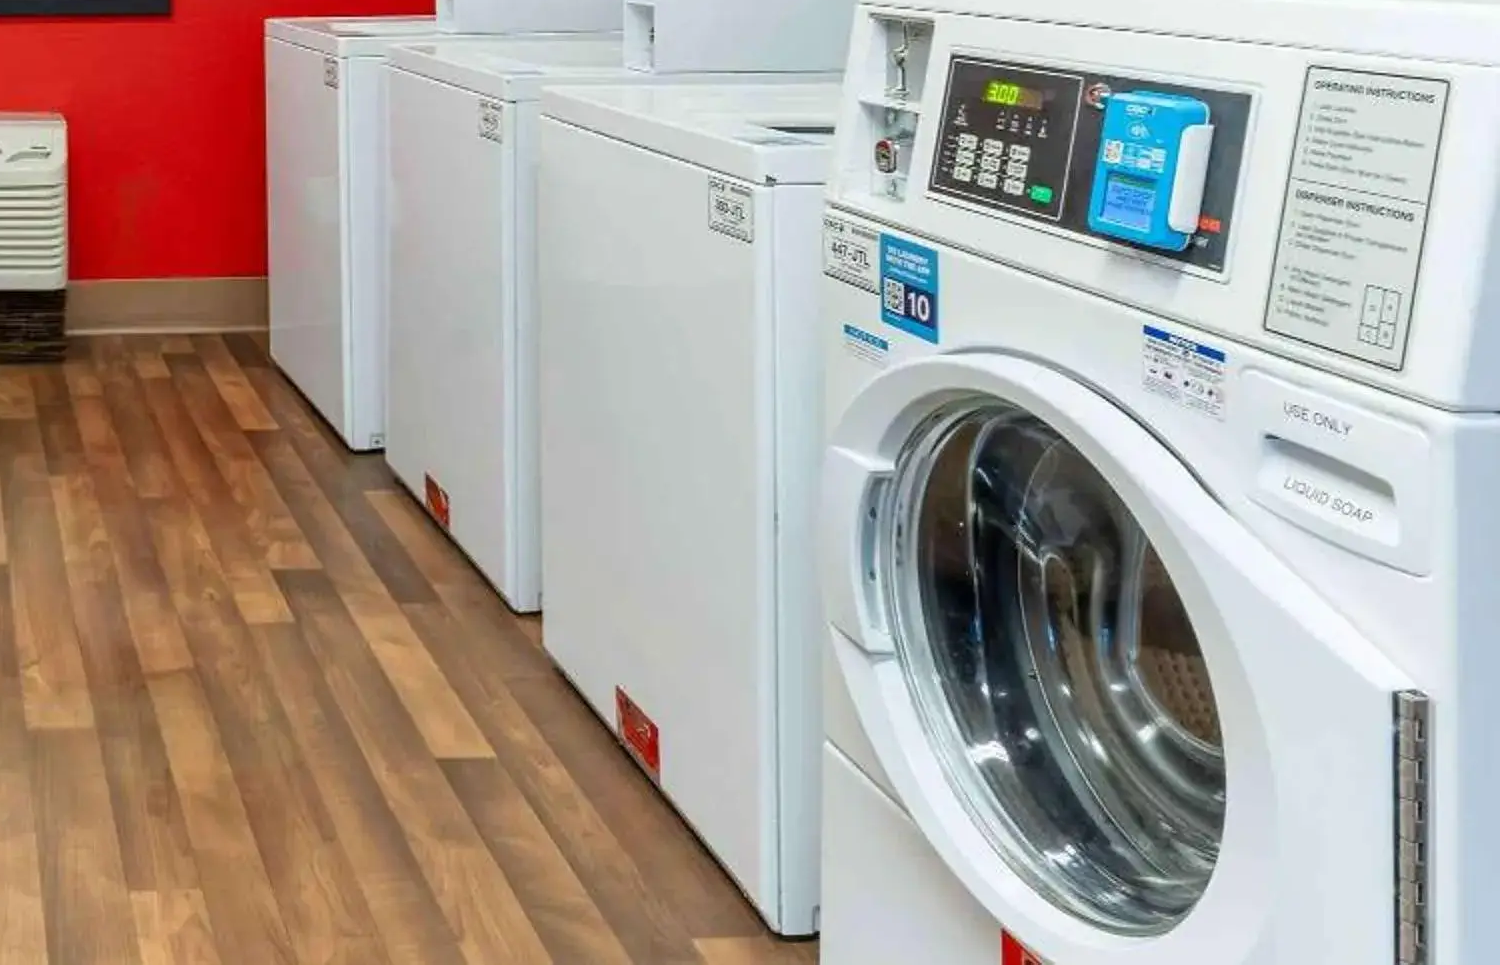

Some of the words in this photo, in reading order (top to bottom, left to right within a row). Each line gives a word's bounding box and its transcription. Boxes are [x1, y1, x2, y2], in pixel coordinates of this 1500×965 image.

[1314, 80, 1364, 95] OPERATING
[1366, 86, 1436, 104] INSTRUCTIONS
[1346, 200, 1415, 222] INSTRUCTIONS
[907, 292, 930, 322] 10
[1283, 400, 1309, 423] USE
[1312, 412, 1354, 436] ONLY
[1283, 475, 1327, 505] LIQUID
[1329, 496, 1374, 523] SOAP
